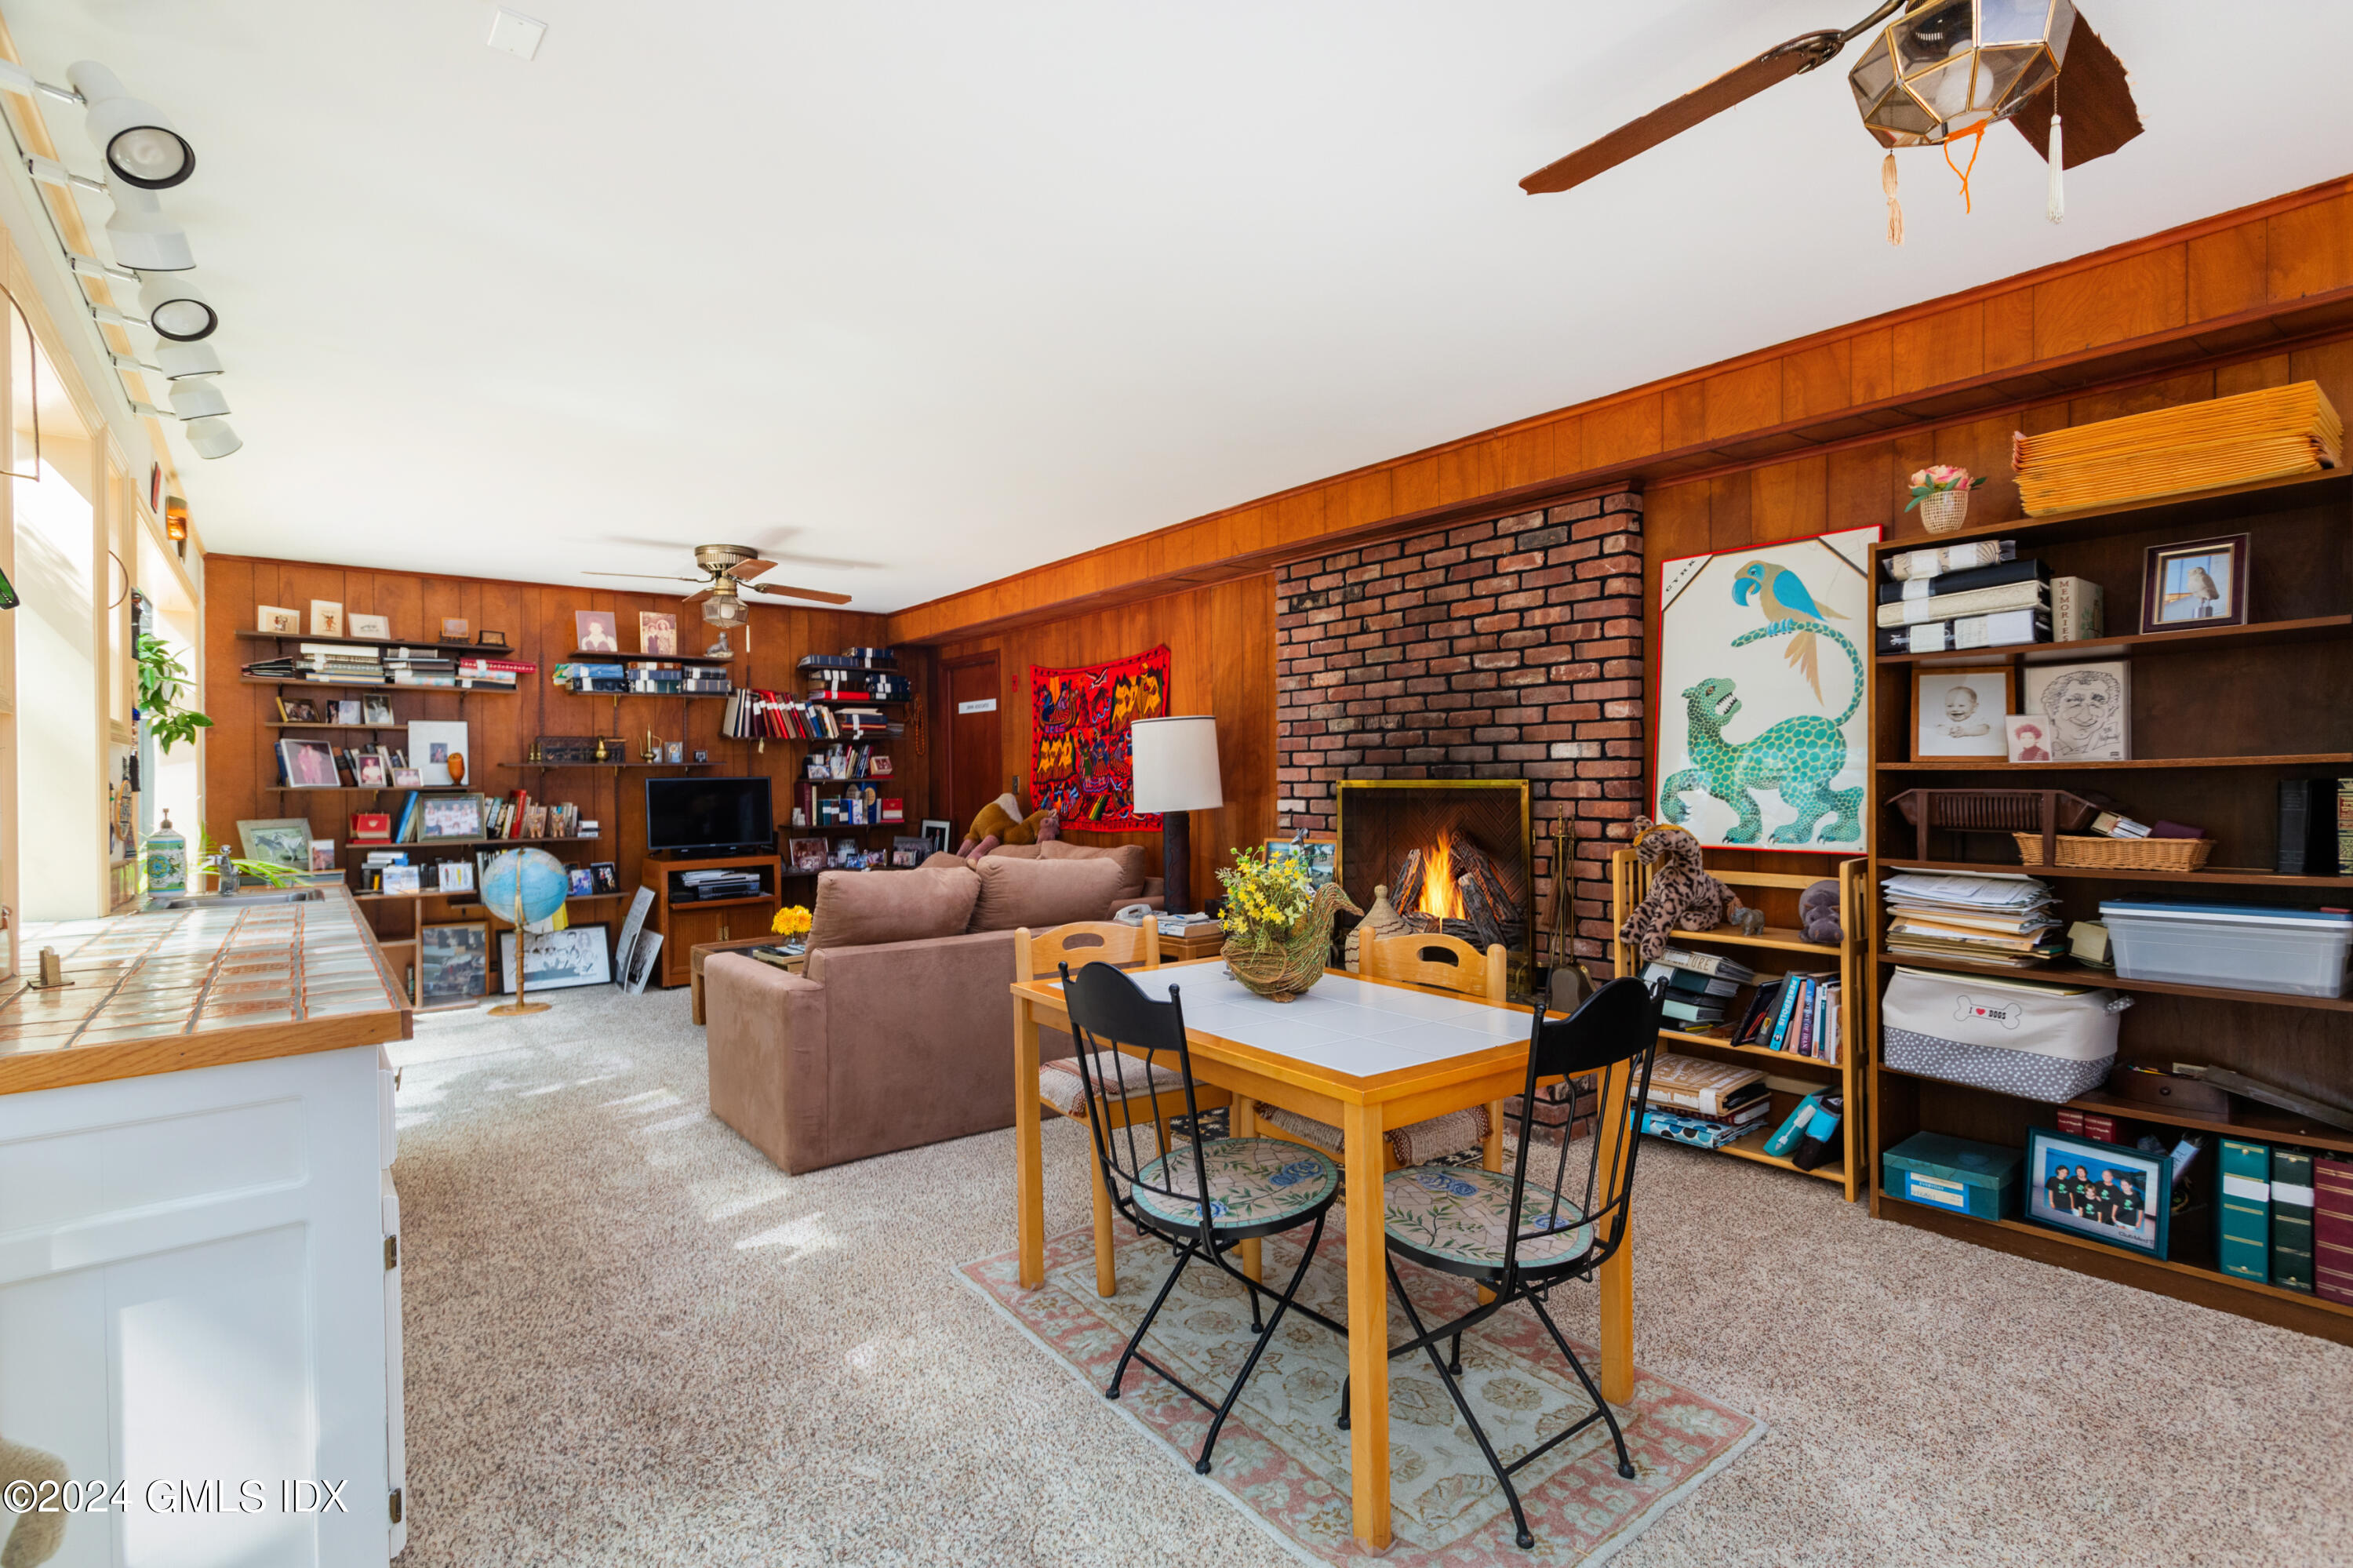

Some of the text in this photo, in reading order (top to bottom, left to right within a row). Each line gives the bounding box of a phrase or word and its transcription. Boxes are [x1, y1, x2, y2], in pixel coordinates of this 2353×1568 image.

[2059, 580, 2070, 642] MEMORIES
[1778, 980, 1798, 1027] PERSEPOLIS
[1804, 995, 1813, 1021] HISTORY
[1988, 1010, 2007, 1020] DOGS
[1803, 1023, 1810, 1031] OF
